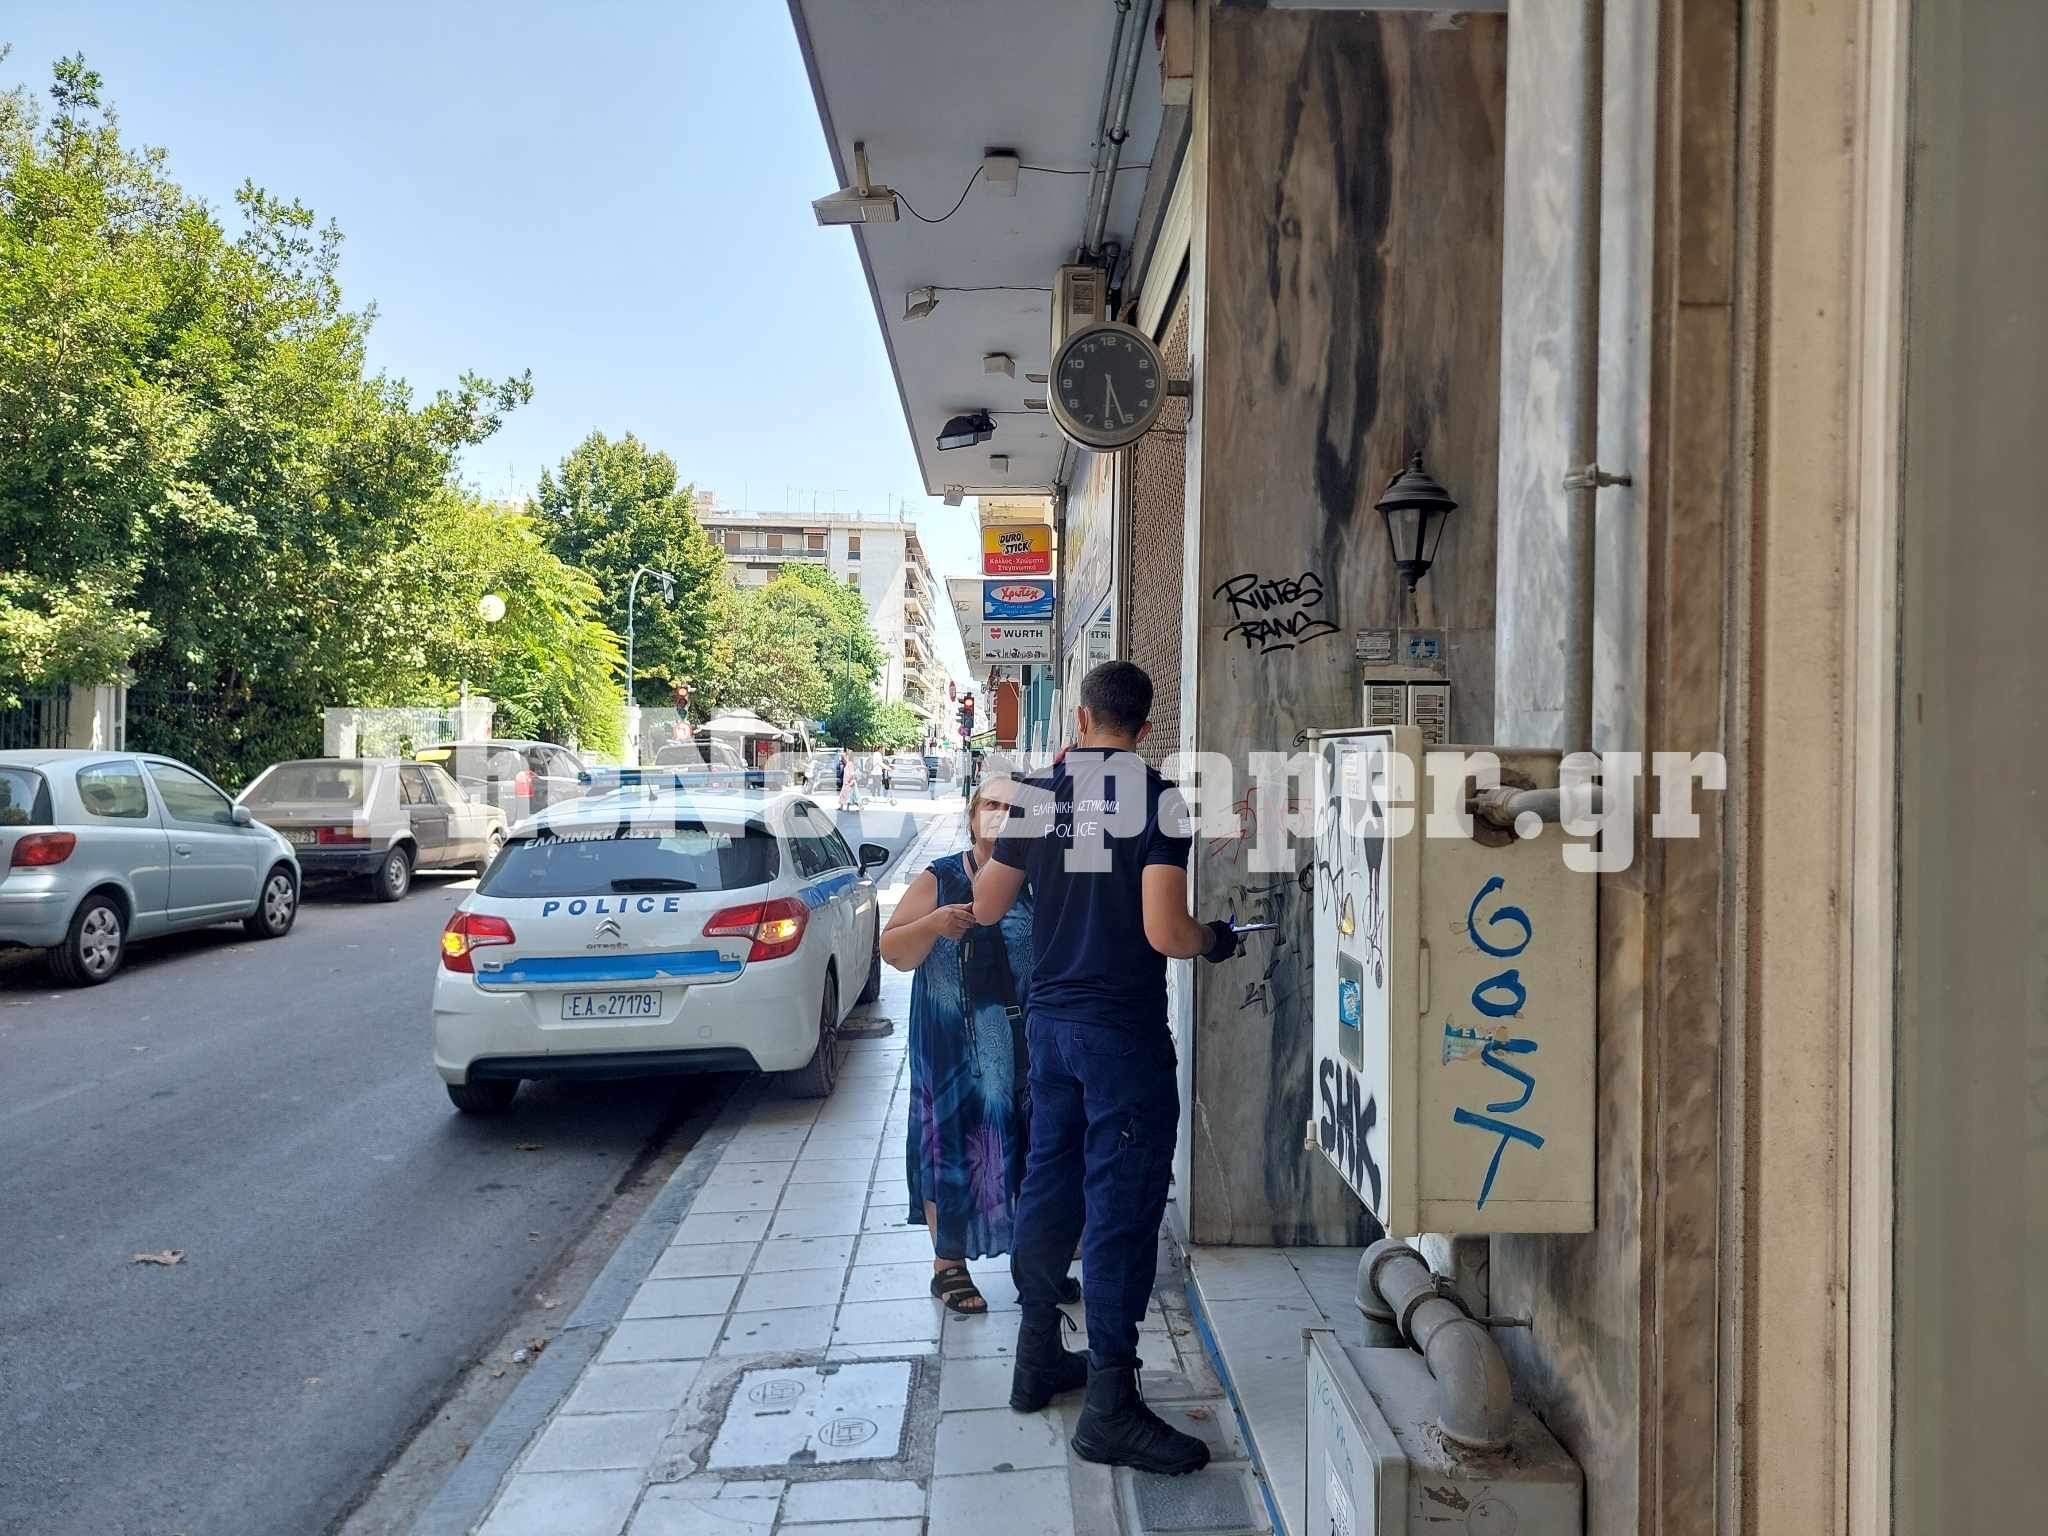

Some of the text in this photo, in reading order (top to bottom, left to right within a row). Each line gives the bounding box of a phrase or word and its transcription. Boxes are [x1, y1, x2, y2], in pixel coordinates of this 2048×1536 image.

[1101, 336, 1118, 346] 12
[1081, 343, 1095, 352] 11
[1125, 343, 1132, 352] 1
[1068, 359, 1085, 369] 10
[1139, 359, 1149, 369] 2
[1063, 378, 1073, 389] 9
[1145, 378, 1155, 388] 3
[1069, 399, 1079, 409] 8
[1138, 399, 1148, 408] 4
[1084, 414, 1094, 423] 7
[1124, 413, 1134, 423] 5
[1104, 419, 1114, 430] 6
[1000, 532, 1021, 544] DURO
[1005, 540, 1030, 555] STICK
[1044, 821, 1098, 839] POLICE
[542, 897, 680, 917] POLICE
[608, 994, 652, 1015] 27179
